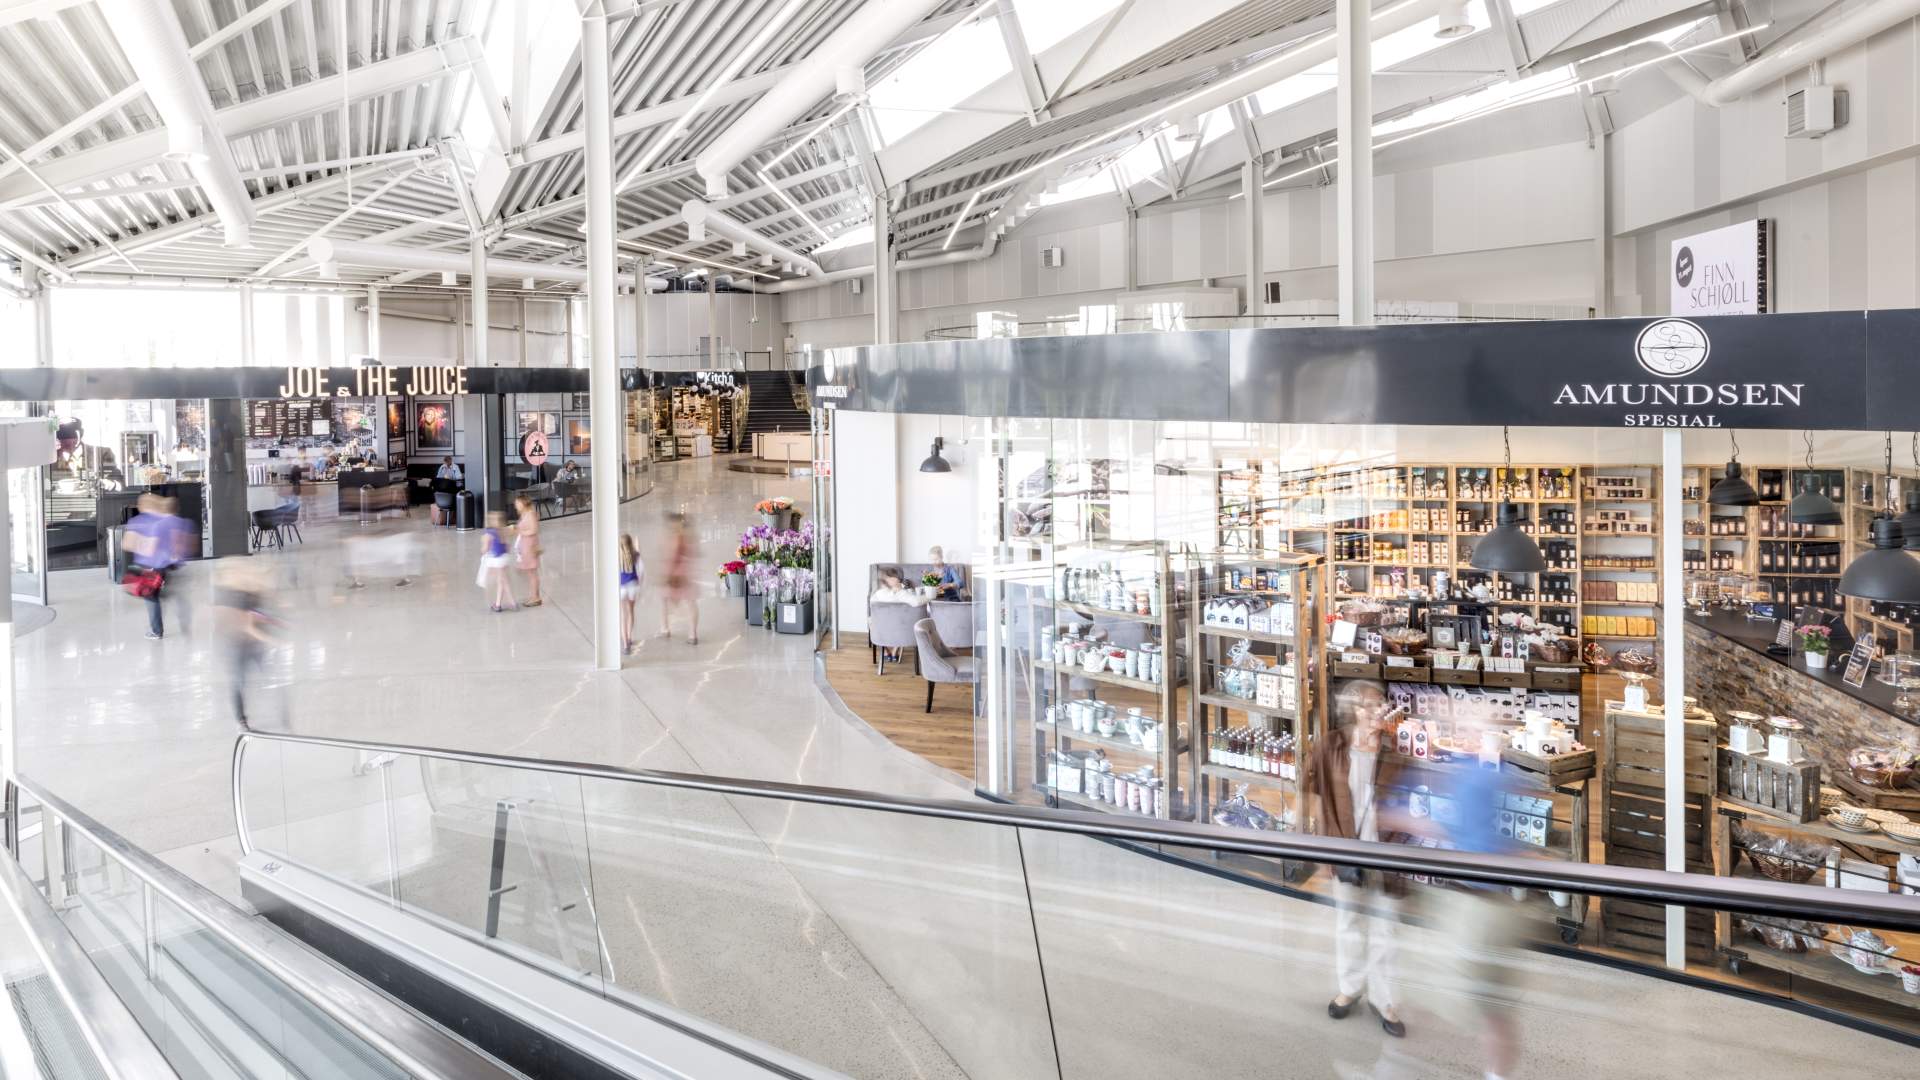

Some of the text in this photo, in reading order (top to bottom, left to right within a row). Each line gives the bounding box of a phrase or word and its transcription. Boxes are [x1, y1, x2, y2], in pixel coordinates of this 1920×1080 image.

[1704, 261, 1735, 285] FINN
[1690, 281, 1749, 309] SCHJØLL
[280, 365, 469, 397] JOE & THE JUICE
[1553, 383, 1805, 406] AMUNDSEN
[1624, 414, 1721, 428] SPESIAL
